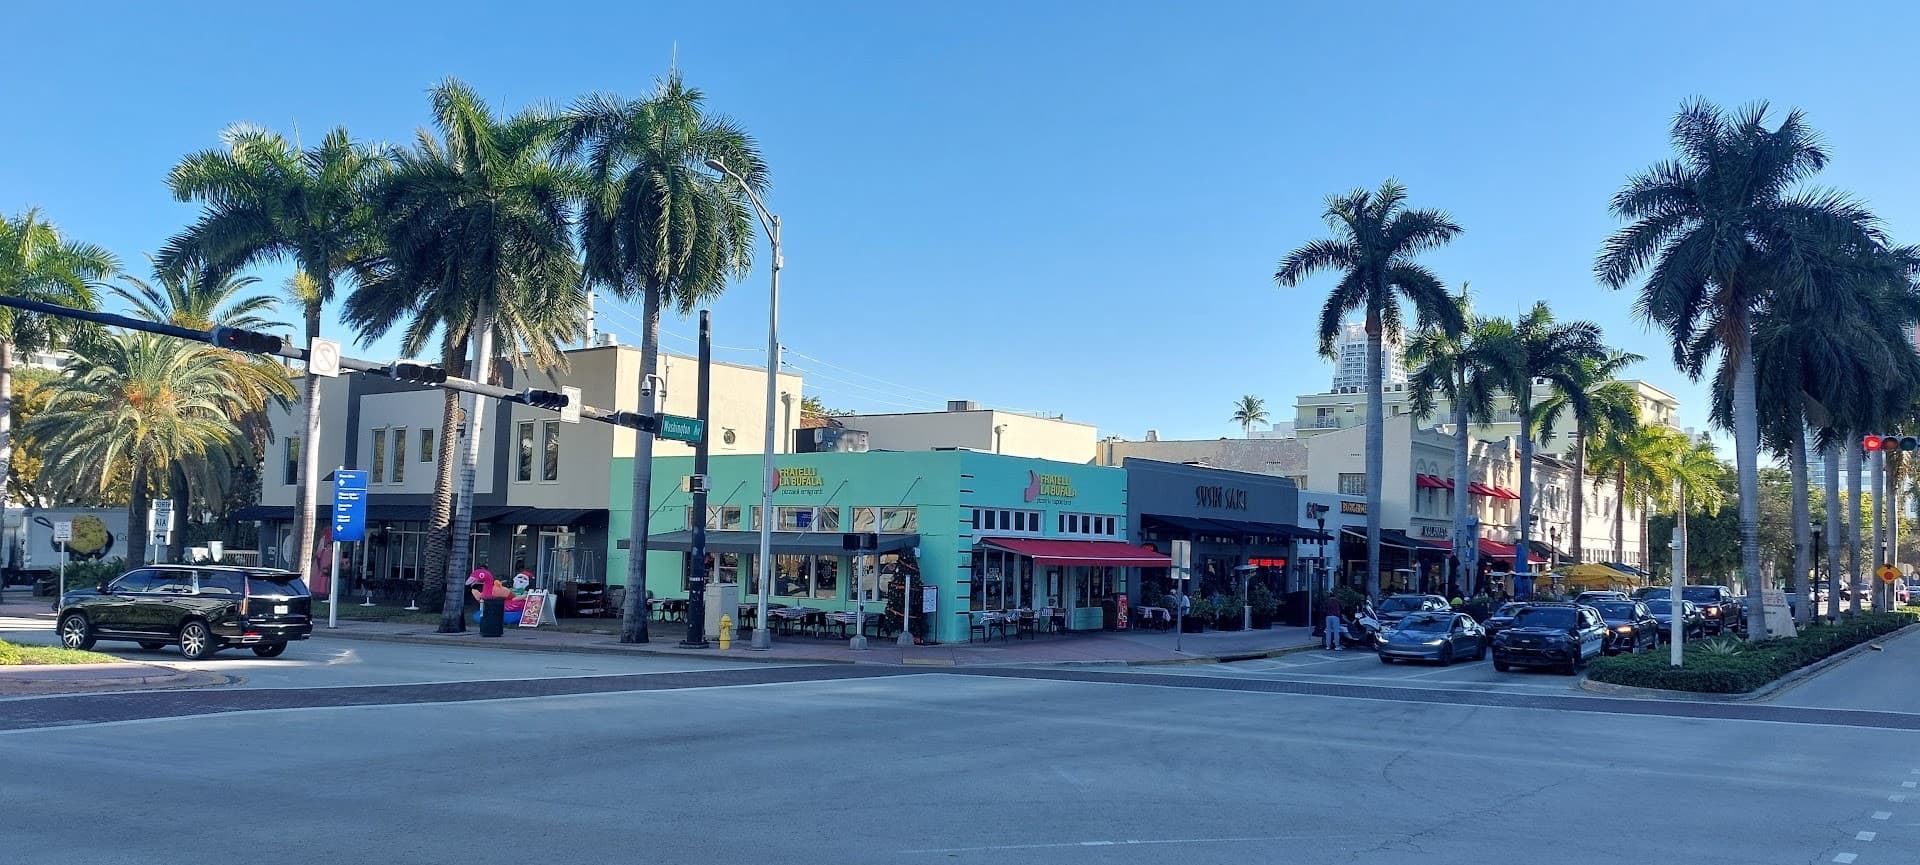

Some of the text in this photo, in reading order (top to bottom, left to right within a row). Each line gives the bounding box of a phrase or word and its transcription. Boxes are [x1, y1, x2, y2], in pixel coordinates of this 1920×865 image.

[664, 420, 691, 437] Washington
[780, 467, 817, 477] FRATELLI
[780, 476, 824, 487] LA BUFALA
[1040, 473, 1072, 487] FRATELLI
[1040, 484, 1077, 498] LA BUFALA
[155, 519, 168, 527] A1A
